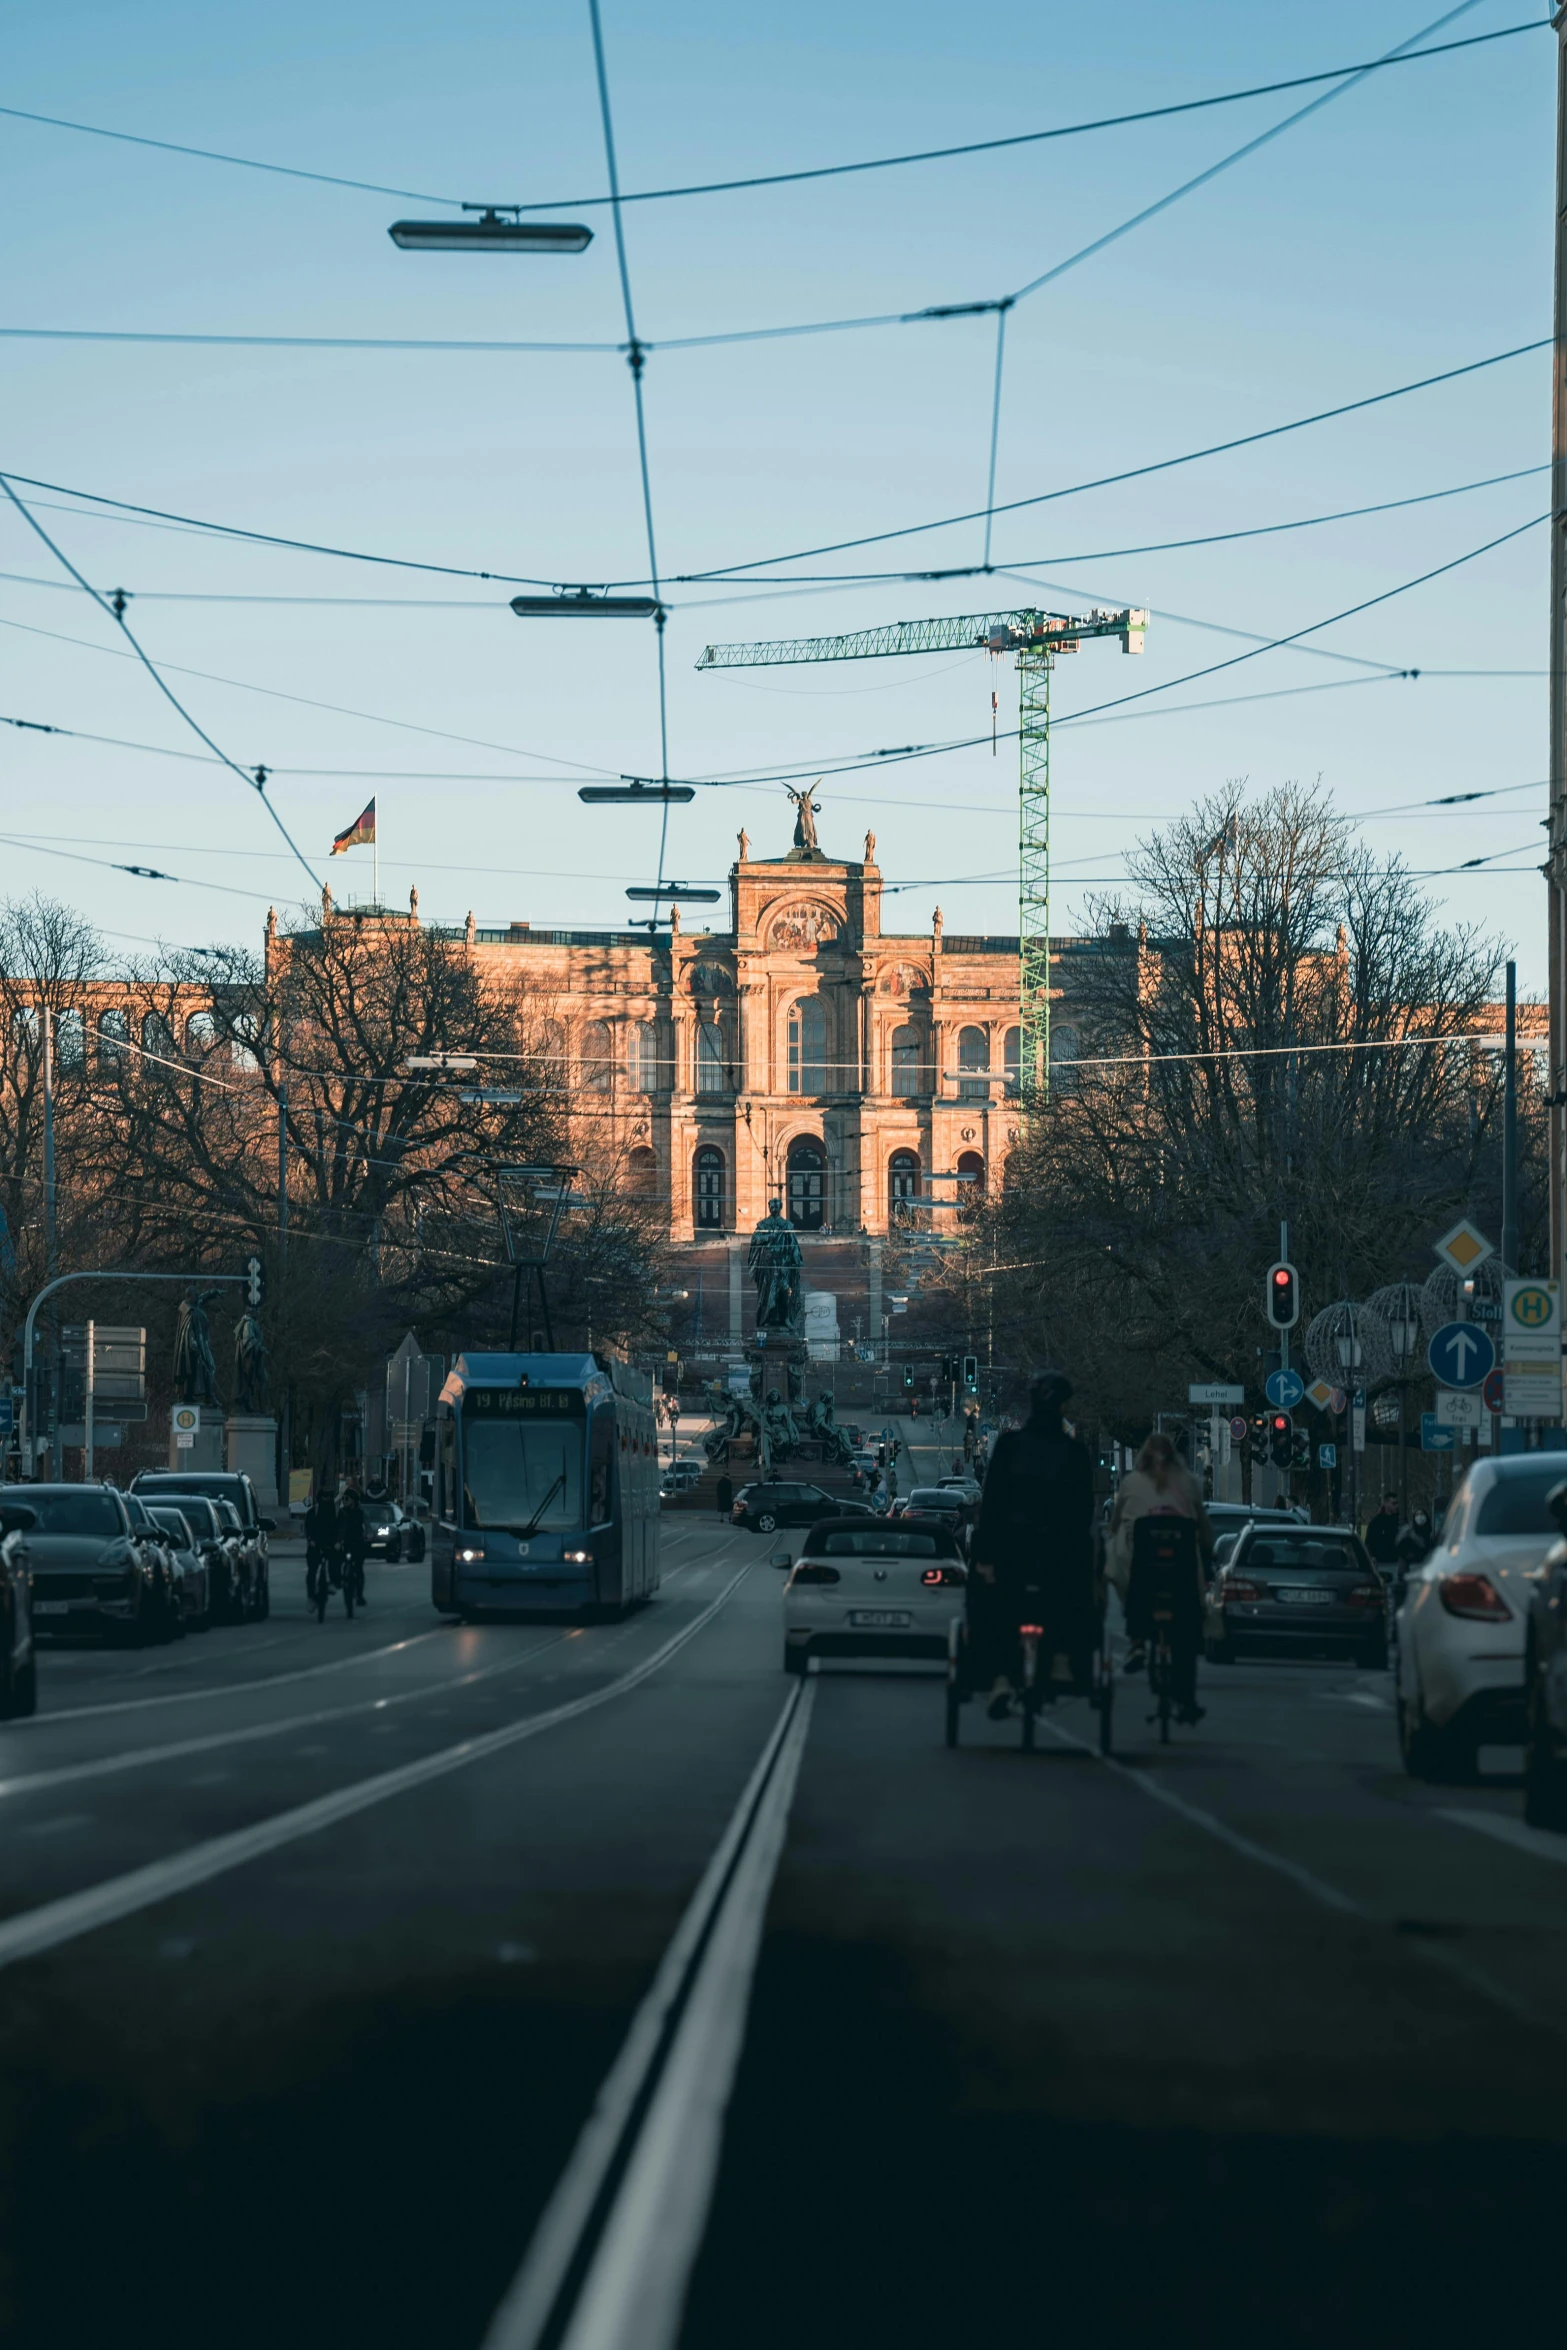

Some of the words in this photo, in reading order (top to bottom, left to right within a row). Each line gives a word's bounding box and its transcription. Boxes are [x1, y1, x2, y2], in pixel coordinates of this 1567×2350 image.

[1522, 1296, 1542, 1318] H
[476, 1393, 491, 1408] 19
[499, 1392, 536, 1409] Pasing
[1205, 1390, 1228, 1398] Lehel
[1451, 1414, 1467, 1423] frei
